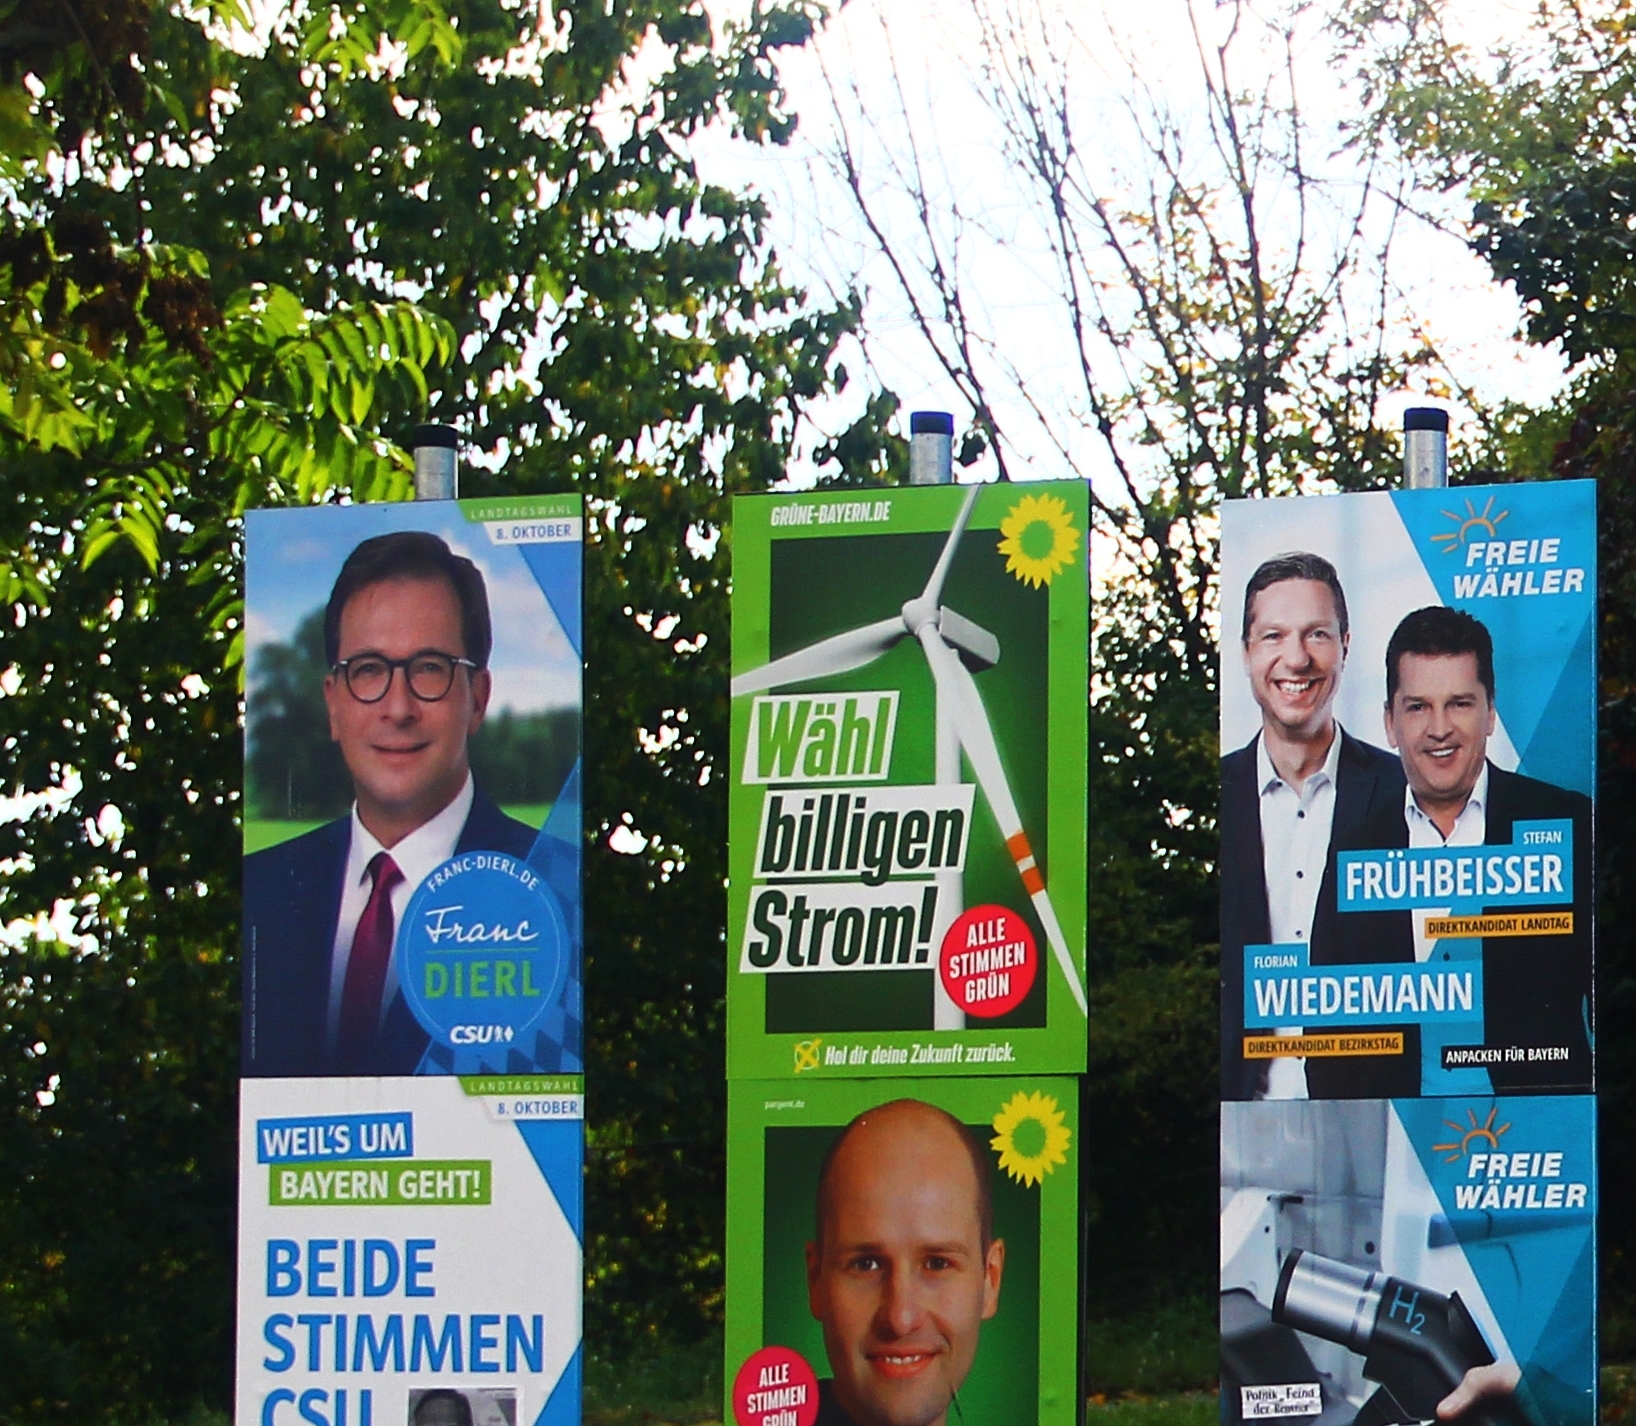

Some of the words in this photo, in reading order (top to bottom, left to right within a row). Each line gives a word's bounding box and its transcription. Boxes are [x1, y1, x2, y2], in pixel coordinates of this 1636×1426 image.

[470, 504, 572, 520] LANDTAGSWAHL
[771, 502, 891, 526] GRÜNE-BAYERN.DE
[512, 524, 572, 539] OKTOBER
[1466, 538, 1561, 566] FREIE
[1453, 567, 1584, 598] WÄHLER
[757, 699, 887, 778] Wähl
[761, 793, 965, 886] billigen
[1523, 830, 1562, 845] STEFAN
[426, 856, 540, 894] FRANC-DIERL.DE
[1346, 851, 1563, 900] FRÜHBEISSER
[424, 906, 540, 943] Franc
[748, 886, 939, 968] Strom!
[966, 917, 1005, 946] ALLE
[1428, 917, 1518, 934] DIREKTKANDIDAT
[1521, 915, 1569, 932] LANDTAG
[949, 946, 1025, 978] STIMMEN
[1254, 955, 1298, 969] FLORIAN
[425, 960, 540, 998] DIERL
[965, 972, 1010, 1003] GRÜN
[1254, 972, 1473, 1018] WIEDEMANN
[450, 1025, 494, 1043] CSU
[1247, 1038, 1336, 1054] DIREKTKANDIDAT
[1339, 1036, 1399, 1051] BEZIRKSTAG
[825, 1045, 847, 1065] Hol
[849, 1046, 868, 1065] dir
[871, 1045, 908, 1064] deine
[911, 1043, 963, 1064] Zukunft
[966, 1043, 1016, 1063] zurück.
[1446, 1047, 1501, 1064] ANPACKEN
[1504, 1045, 1525, 1063] FÜR
[1527, 1046, 1569, 1062] BAYERN
[765, 1099, 805, 1111] pargent.de
[361, 1122, 407, 1152] UM
[281, 1171, 389, 1199] BAYERN
[399, 1170, 481, 1198] GEHT!
[267, 1239, 436, 1298] BEIDE
[263, 1314, 544, 1373] STIMMEN
